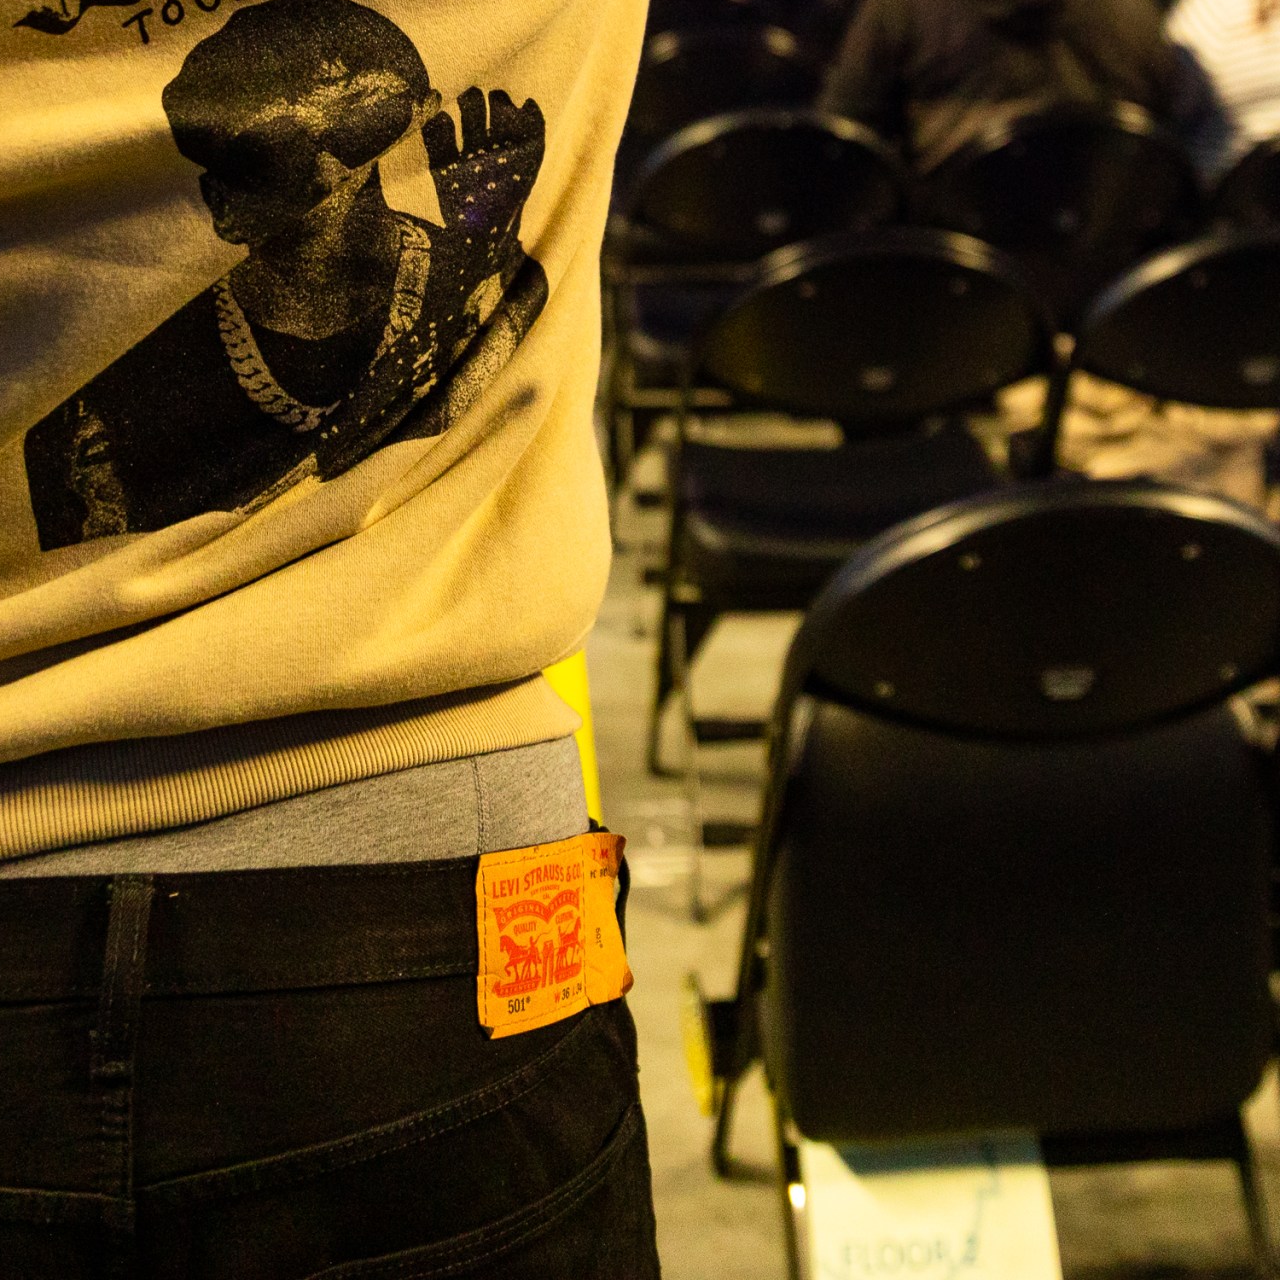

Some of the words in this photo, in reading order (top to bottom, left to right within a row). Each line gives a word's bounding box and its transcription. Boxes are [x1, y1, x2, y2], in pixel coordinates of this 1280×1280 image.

[492, 877, 520, 900] LEVI
[523, 863, 565, 892] STRAUSS
[565, 864, 571, 882] &
[500, 903, 545, 924] ORIGINAL
[514, 921, 537, 935] QUALITY
[554, 991, 561, 1004] W
[561, 987, 570, 1001] 36
